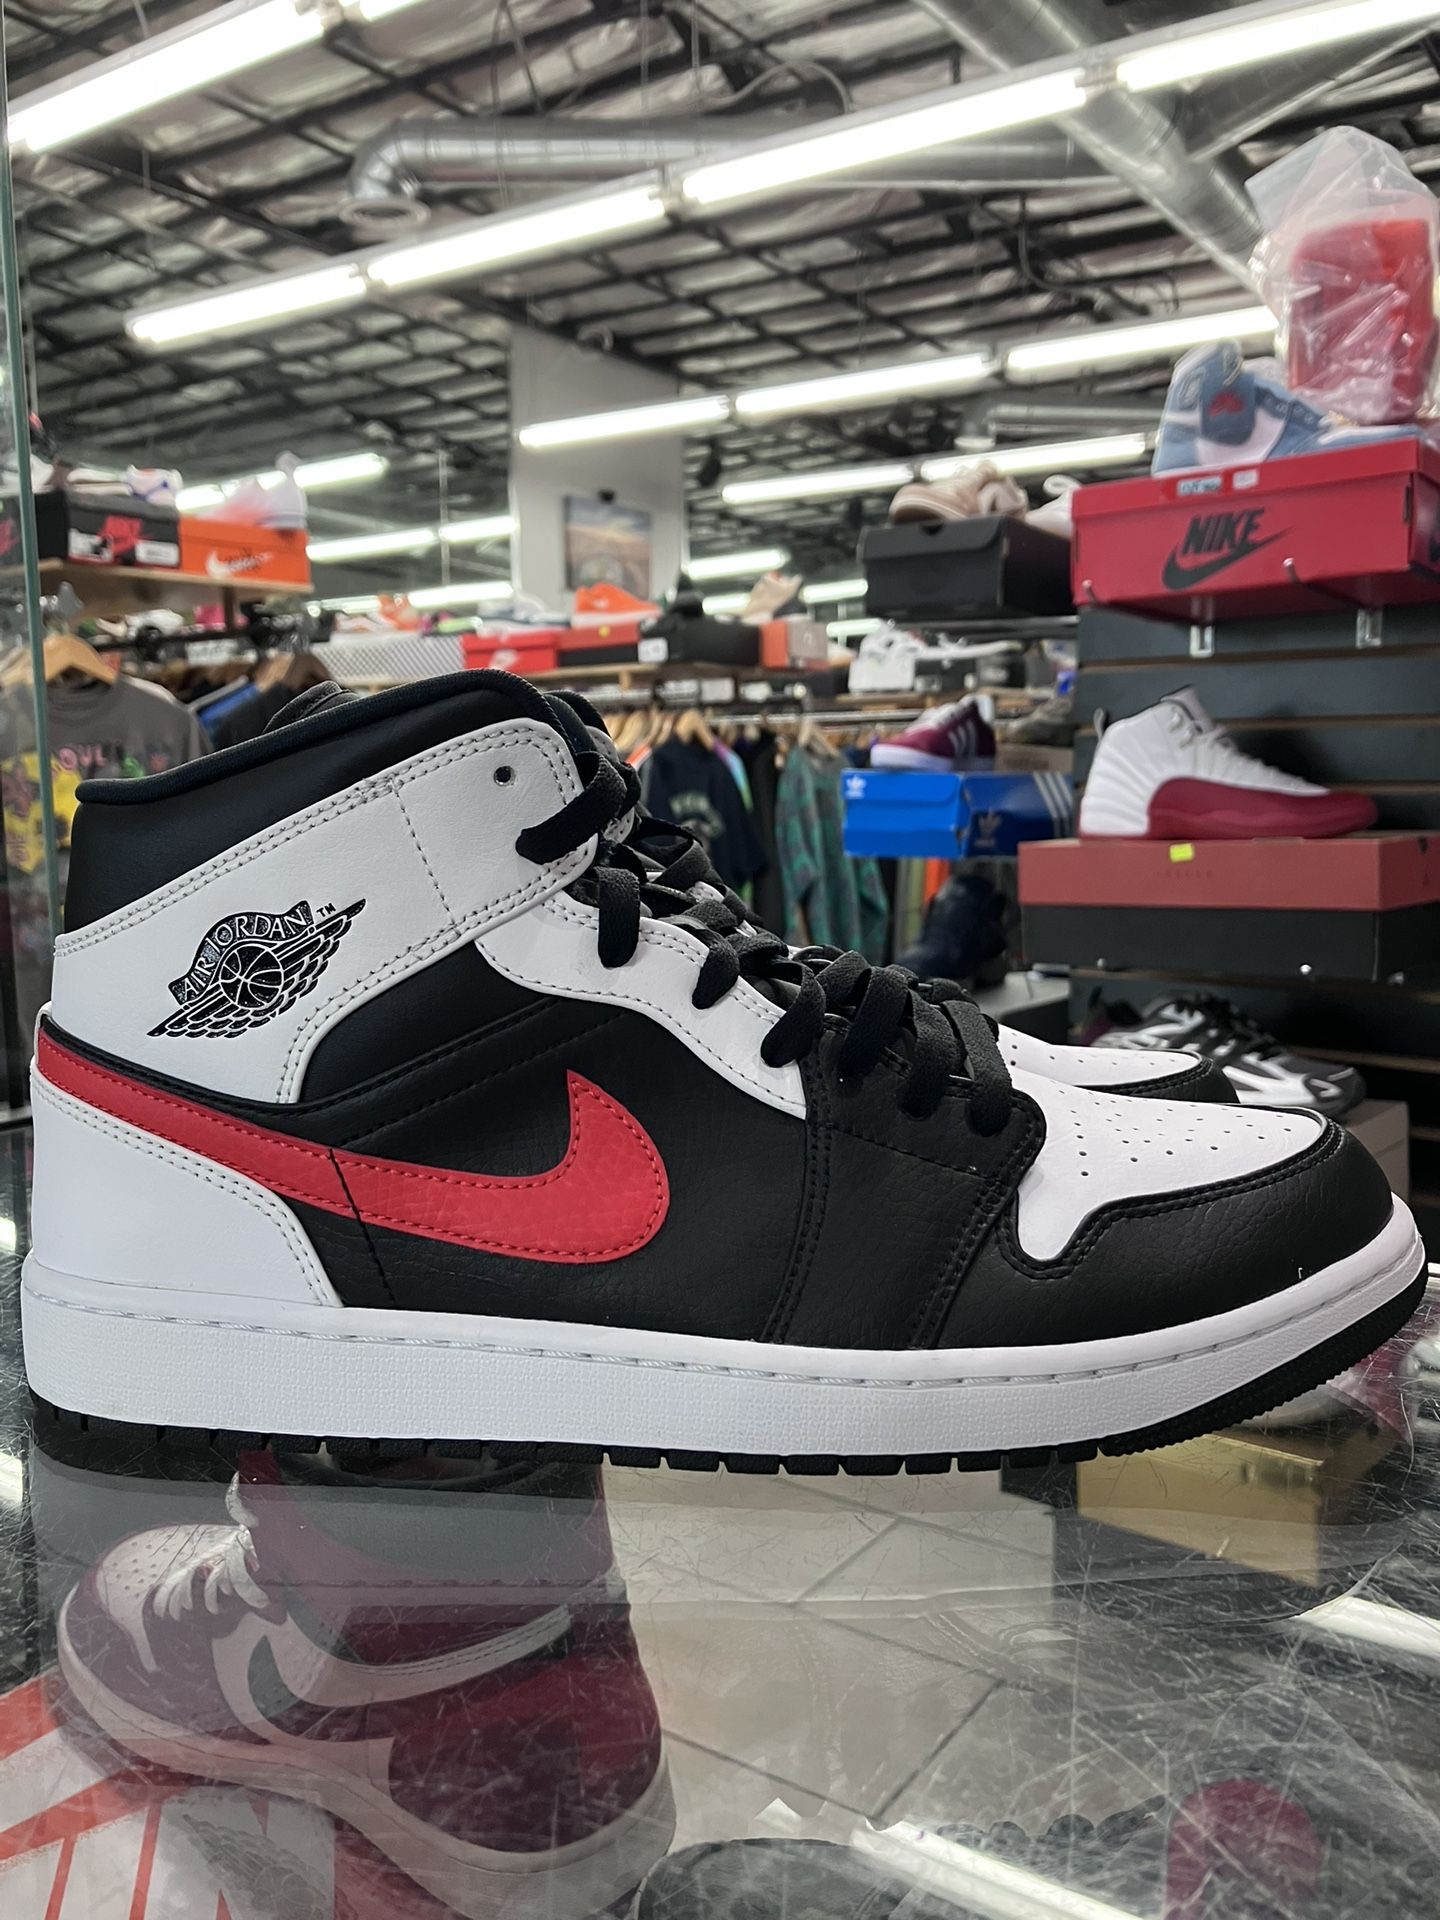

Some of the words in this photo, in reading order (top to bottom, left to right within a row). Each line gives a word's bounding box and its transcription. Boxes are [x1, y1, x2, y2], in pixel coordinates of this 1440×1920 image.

[1181, 508, 1265, 556] NIKE
[182, 957, 216, 1001] AIR
[204, 907, 309, 955] JORDAN
